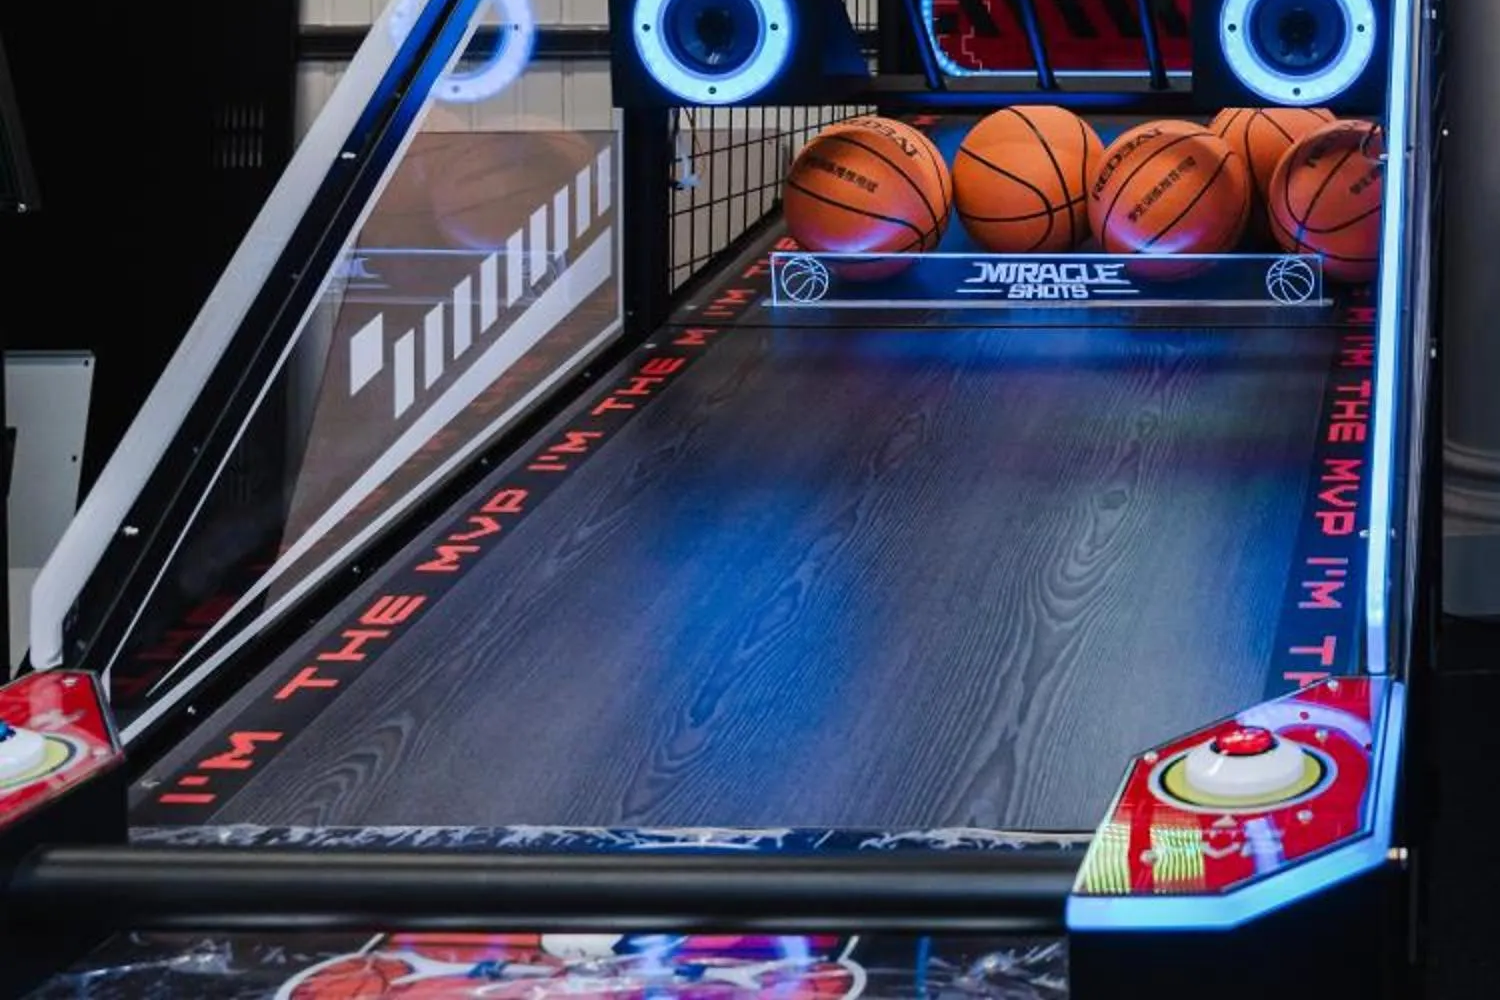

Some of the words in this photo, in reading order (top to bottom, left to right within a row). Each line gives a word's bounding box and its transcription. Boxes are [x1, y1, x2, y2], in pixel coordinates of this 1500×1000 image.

[963, 262, 1132, 285] MIRACLE
[1006, 284, 1090, 300] SHOTS
[1327, 380, 1372, 444] THE
[1314, 458, 1363, 538] MVP
[156, 729, 284, 804] I'M
[273, 594, 428, 699] THE
[414, 487, 530, 572] MVP
[528, 430, 604, 472] I'M
[591, 356, 685, 416] THE
[1297, 556, 1350, 610] I'M
